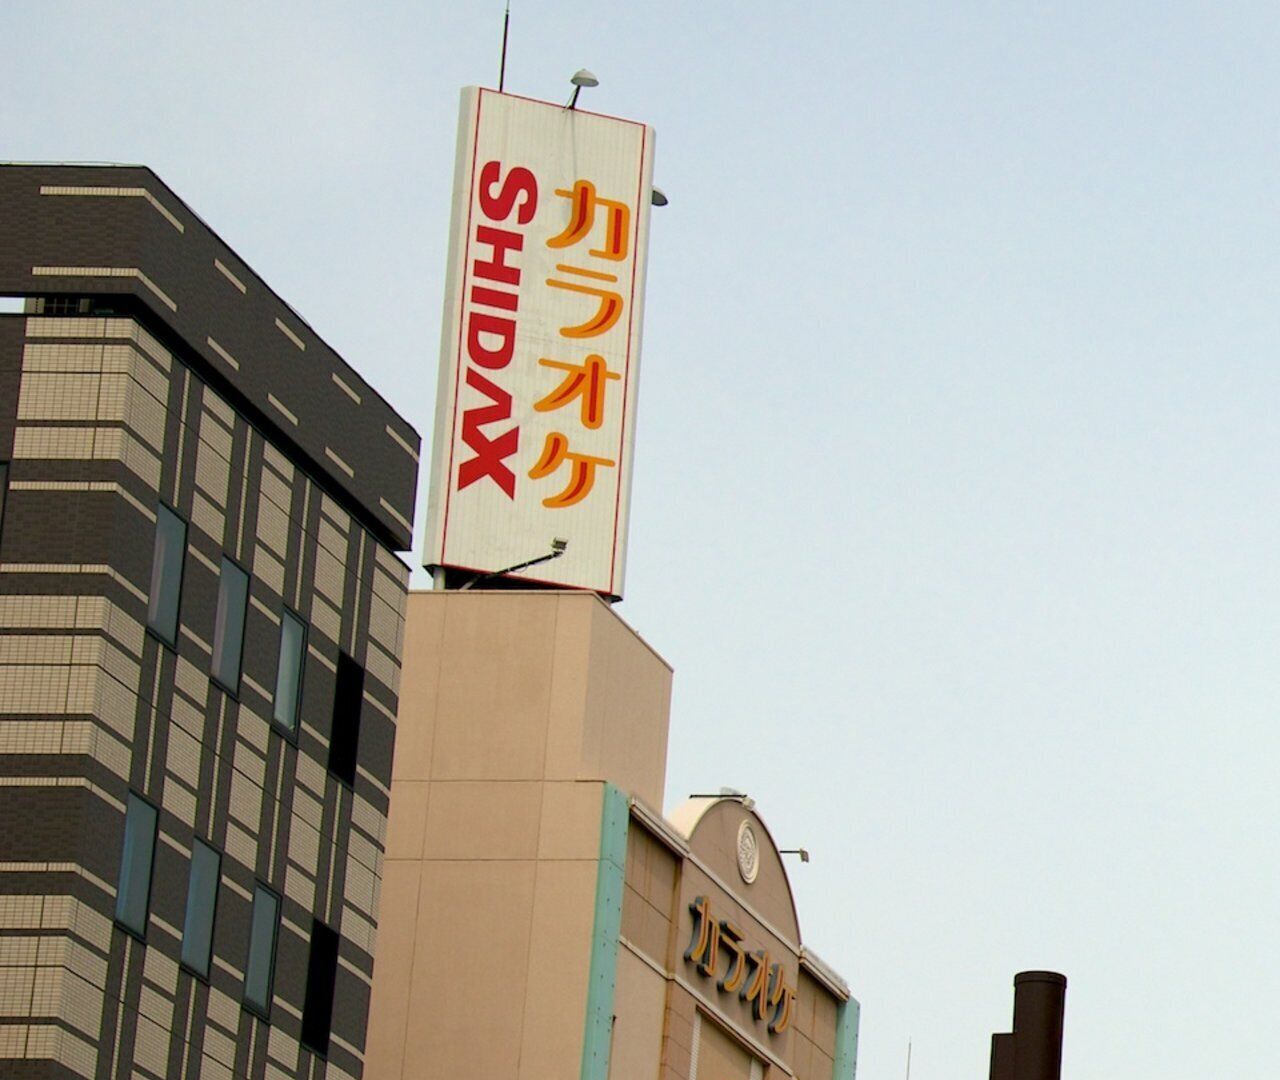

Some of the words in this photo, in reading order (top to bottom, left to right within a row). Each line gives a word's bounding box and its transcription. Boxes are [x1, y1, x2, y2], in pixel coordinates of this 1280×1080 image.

[457, 161, 538, 501] SHIDAX
[528, 179, 631, 509] カラオケ
[684, 896, 796, 1034] カラオケ
